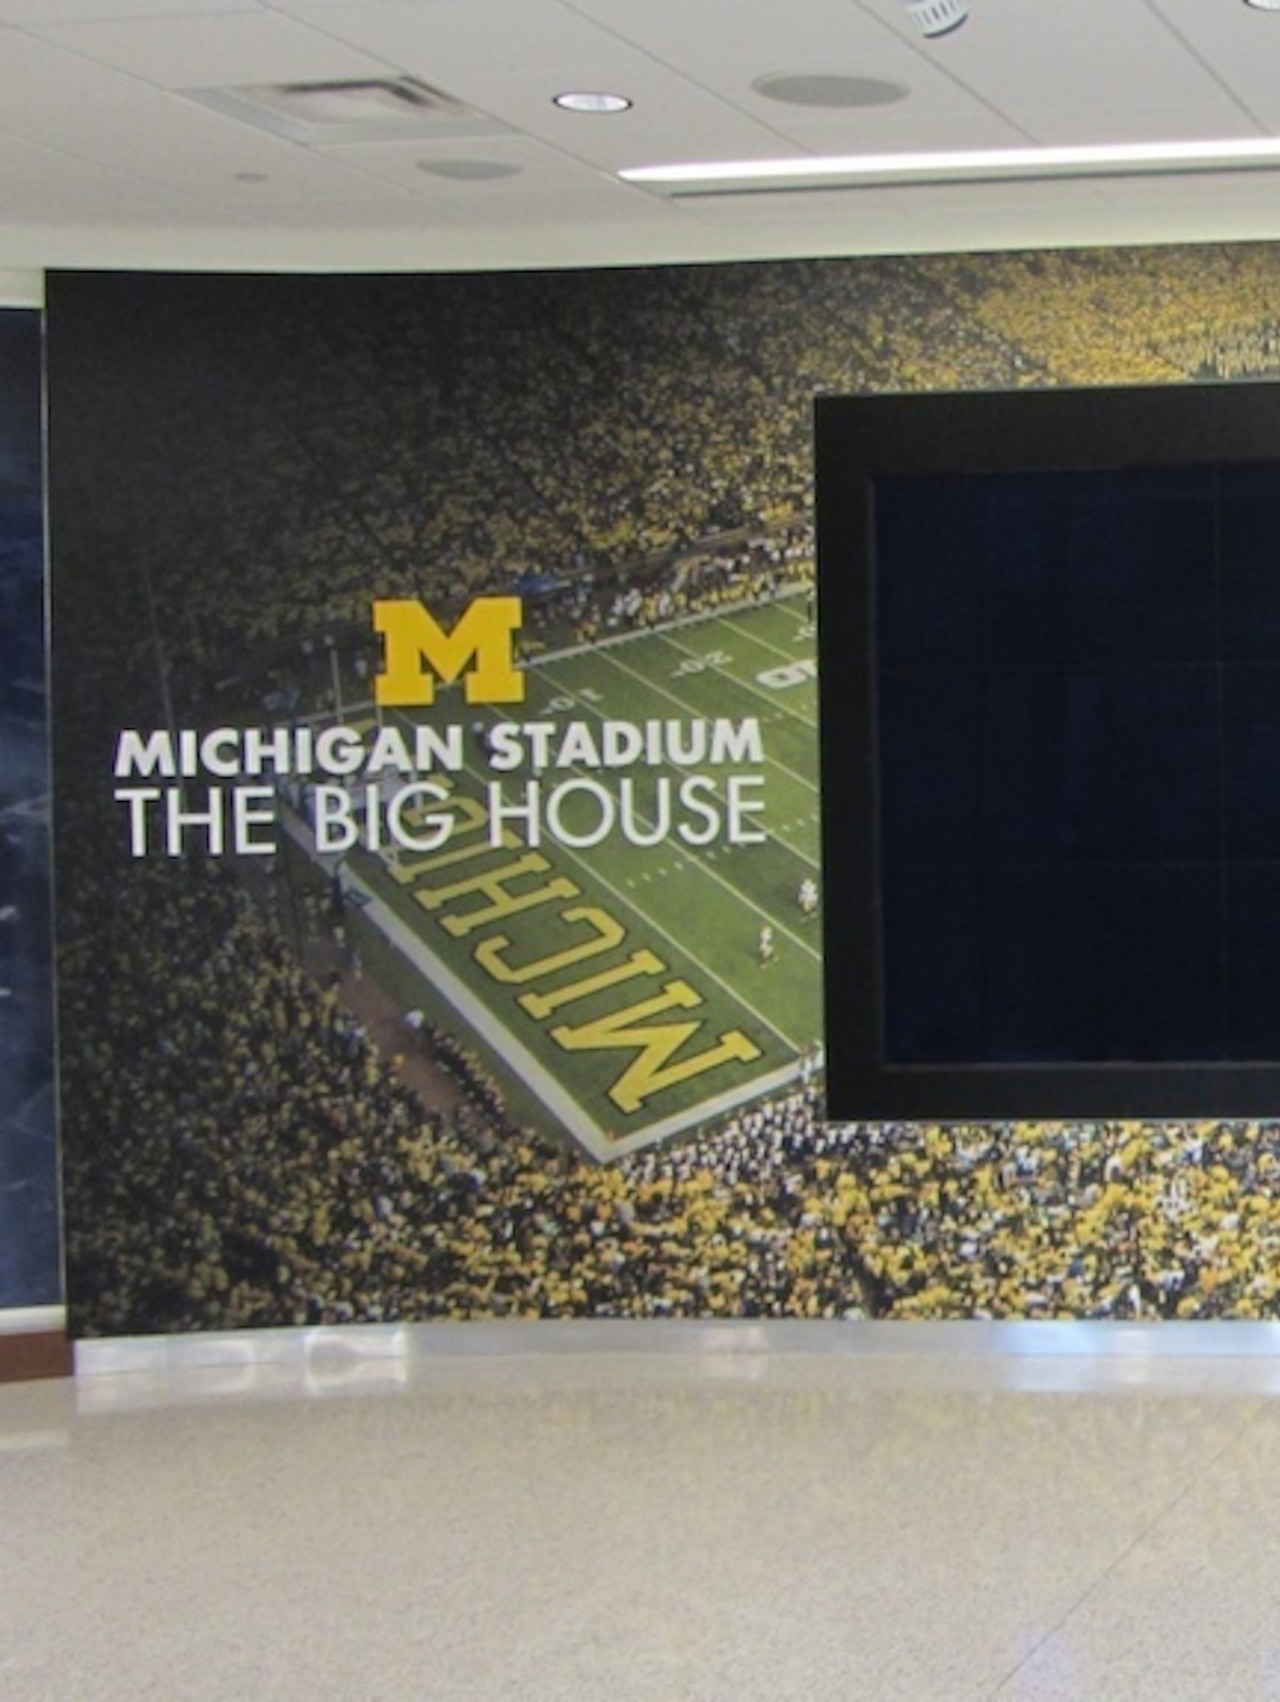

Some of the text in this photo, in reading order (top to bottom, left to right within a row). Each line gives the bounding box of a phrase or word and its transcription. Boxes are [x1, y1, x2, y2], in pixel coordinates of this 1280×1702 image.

[373, 597, 525, 706] M
[114, 717, 766, 778] MICHIGAN STADIUM
[113, 774, 768, 858] THE BIG HOUSE
